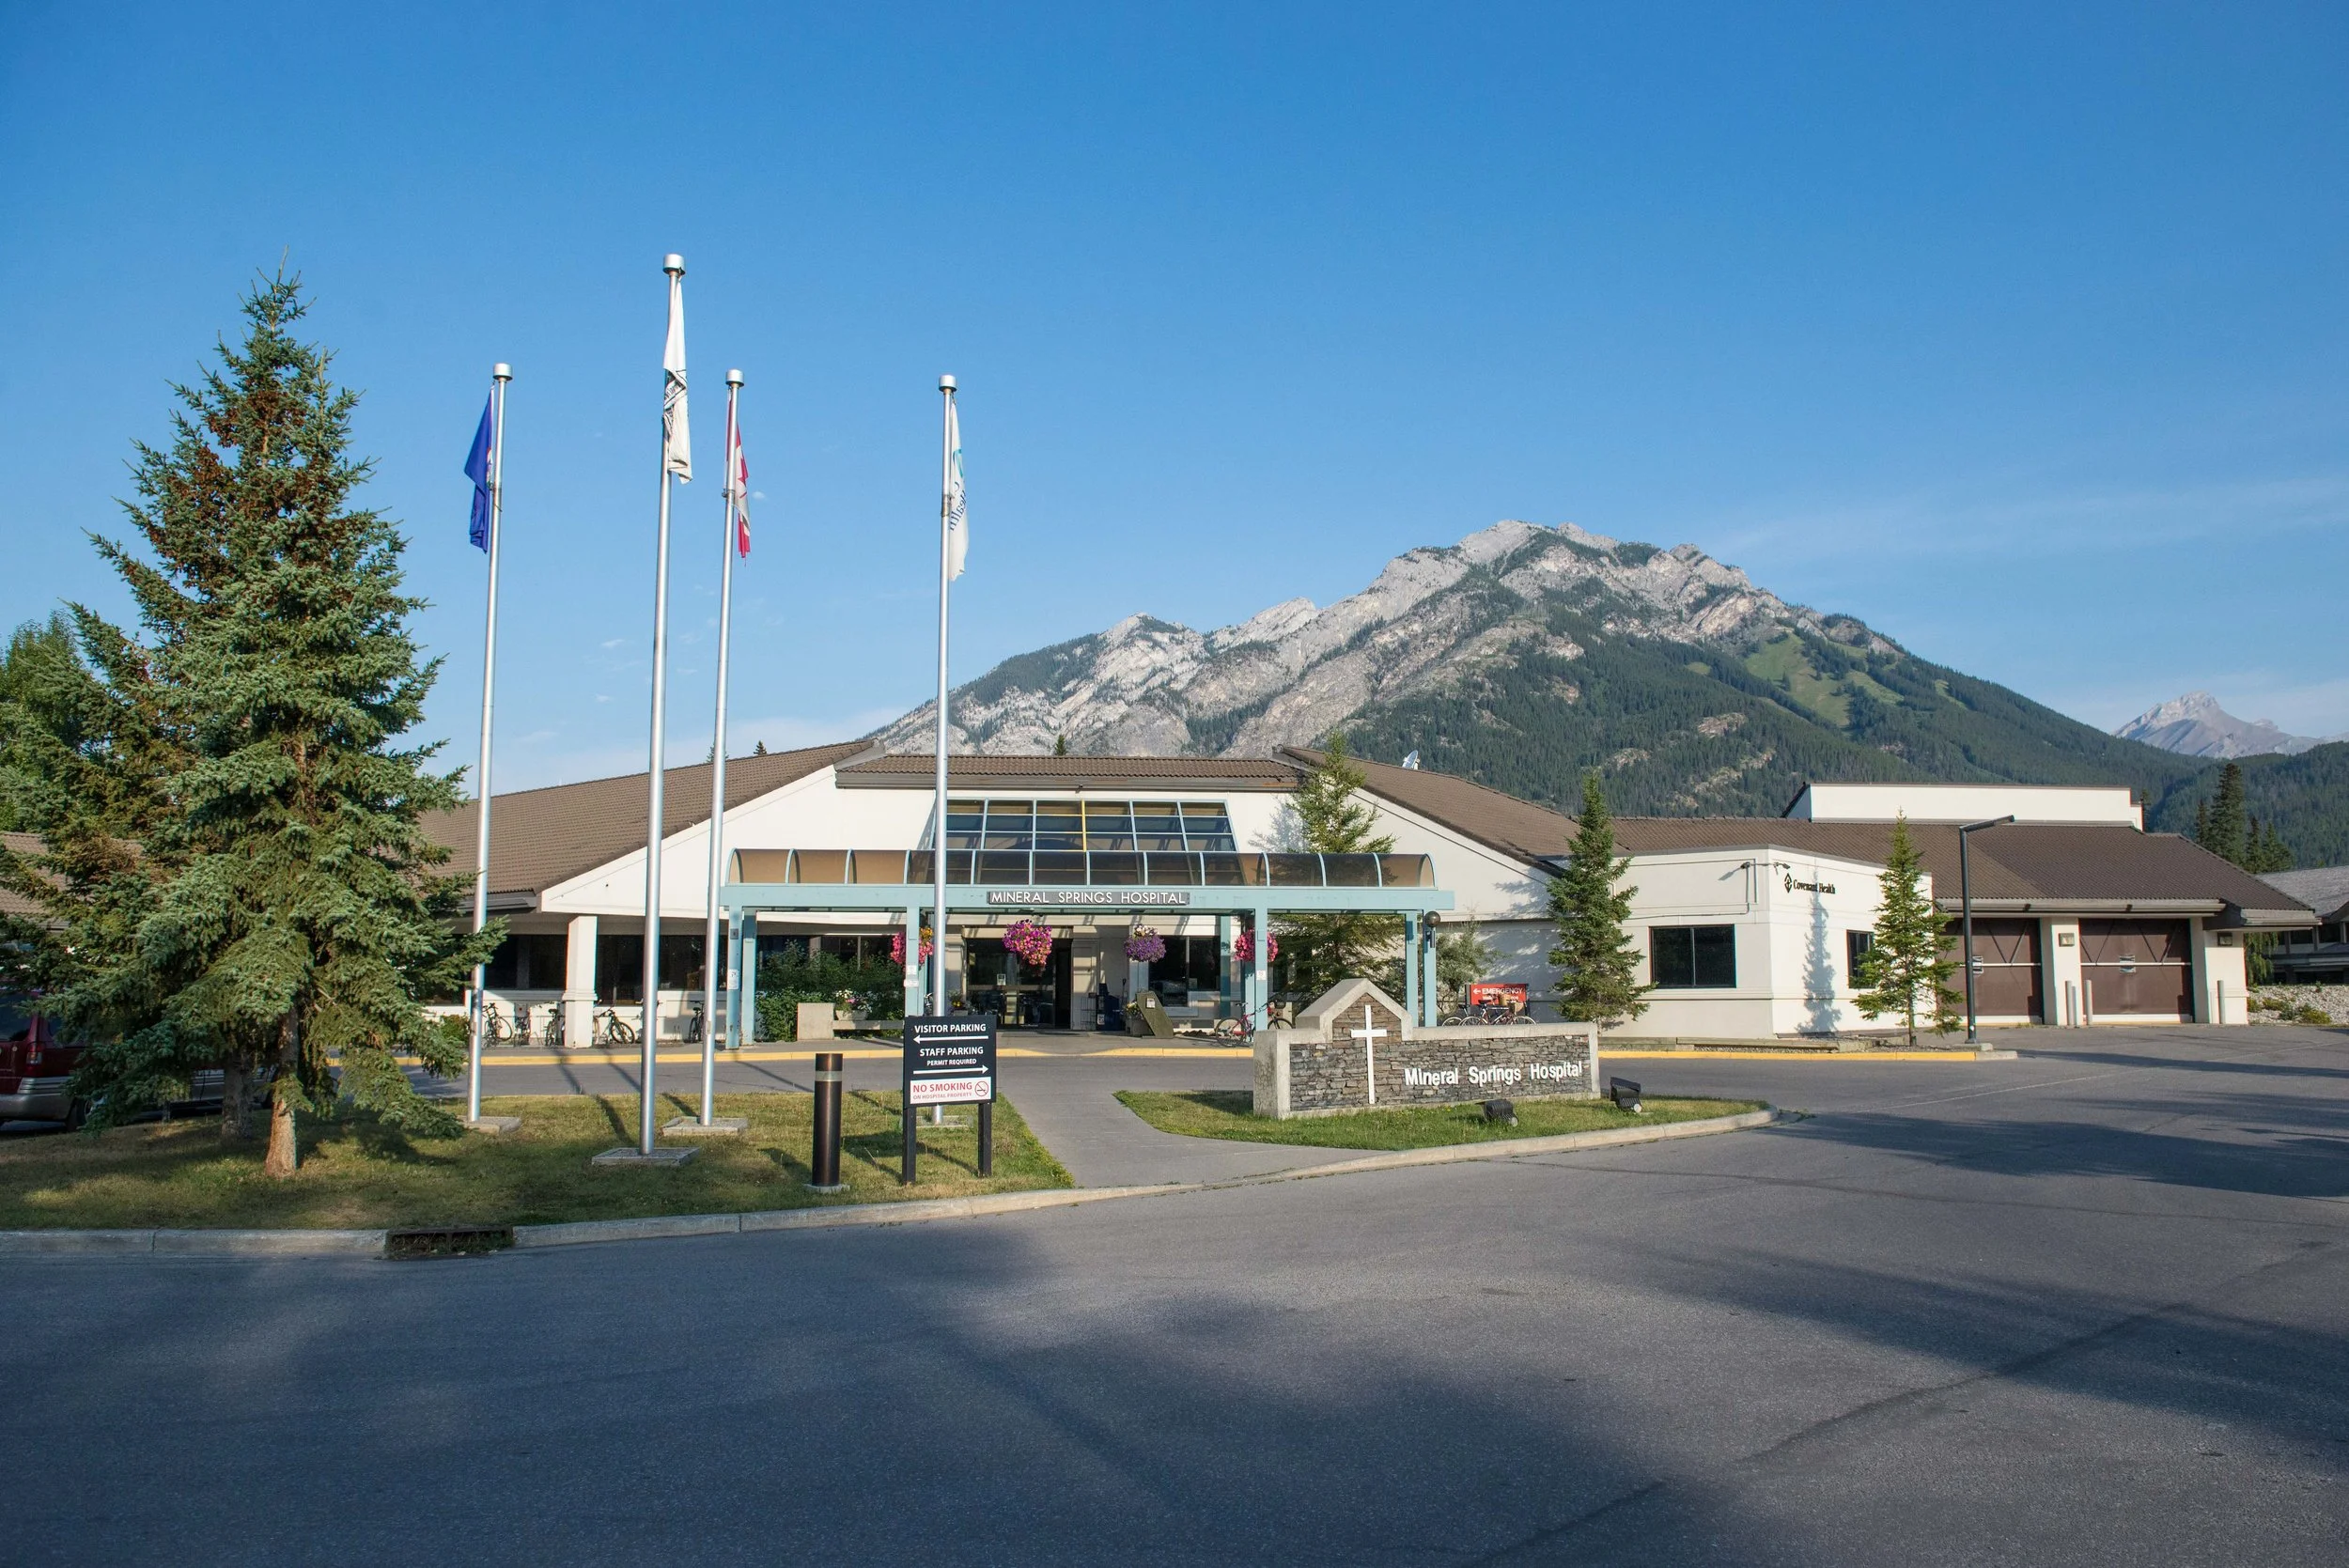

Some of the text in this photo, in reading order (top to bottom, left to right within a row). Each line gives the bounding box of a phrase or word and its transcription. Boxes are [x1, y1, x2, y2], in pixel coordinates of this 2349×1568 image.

[1819, 883, 1835, 894] Health
[991, 892, 1186, 904] MINERAL SPRINGS HOSPITAL
[914, 1024, 987, 1033] VISITOR PARKING
[919, 1047, 984, 1057] STAFF PARKING
[1404, 1060, 1582, 1087] Mineral Springs Hospital
[912, 1082, 972, 1093] NO SMOKING
